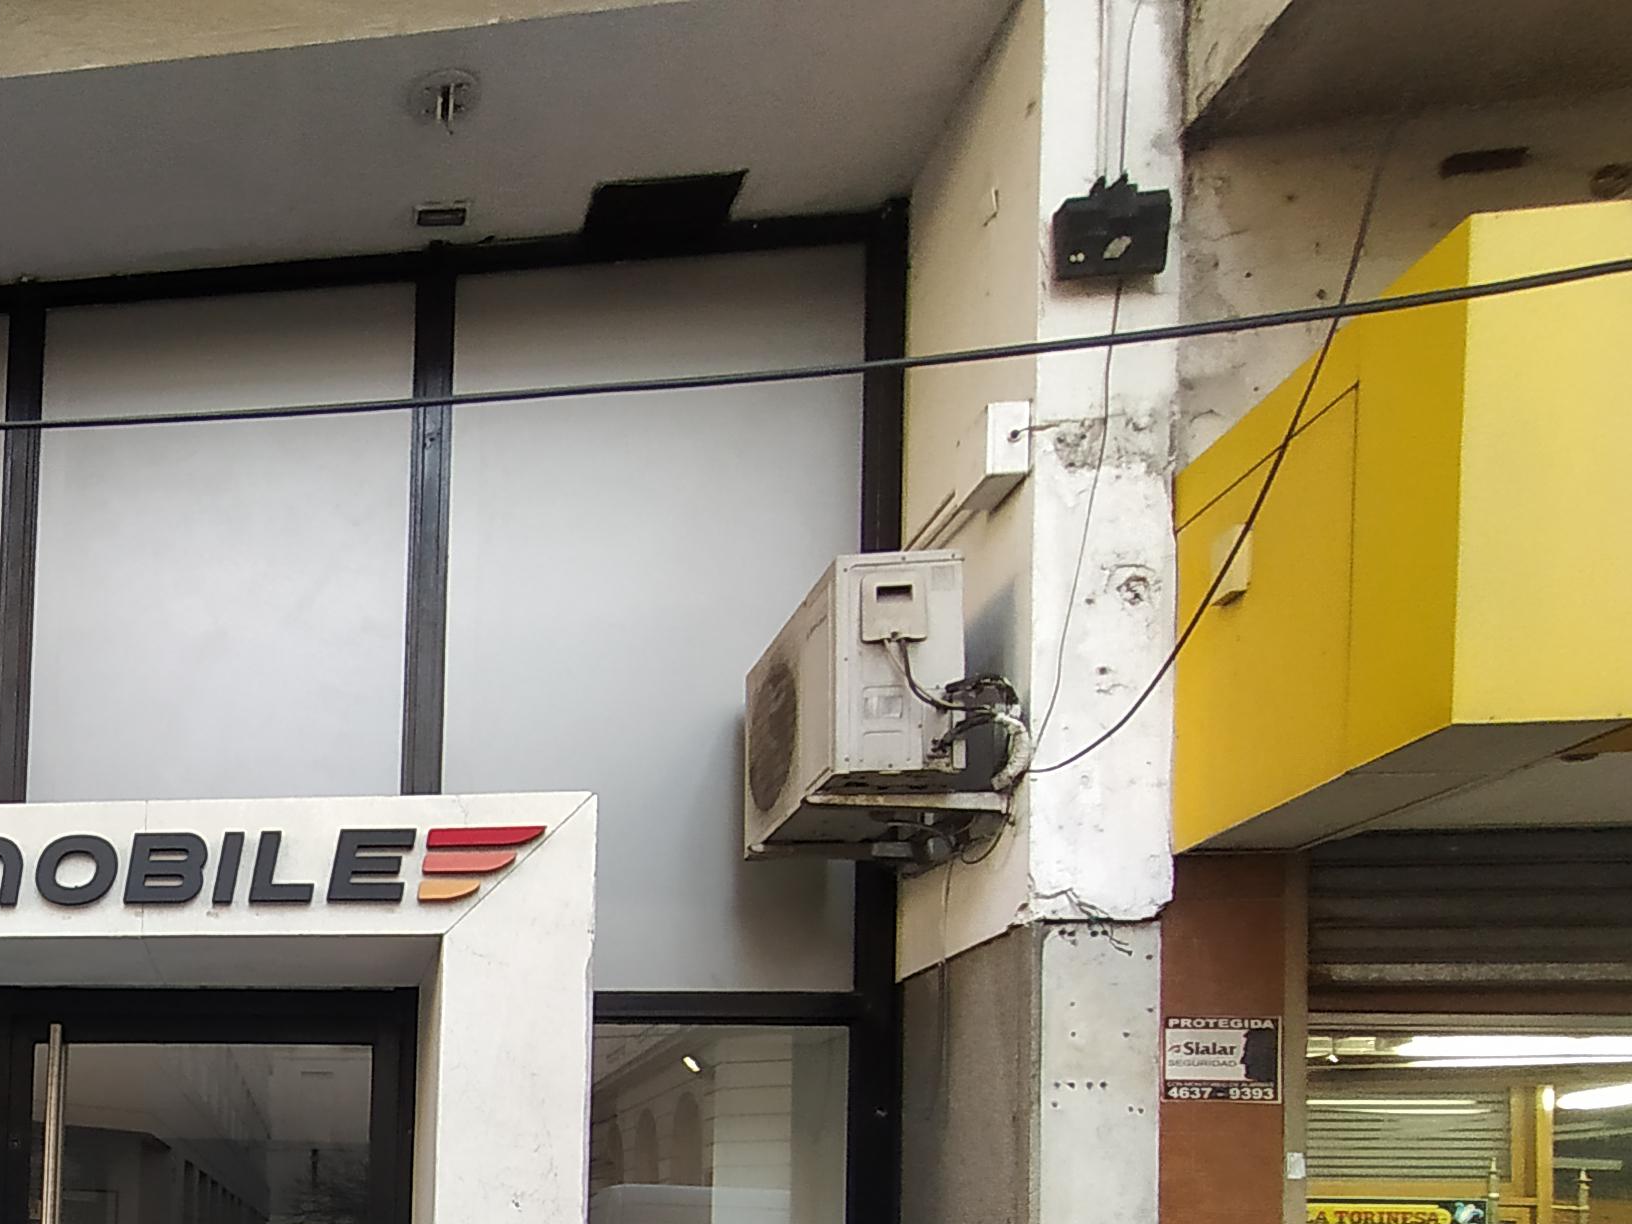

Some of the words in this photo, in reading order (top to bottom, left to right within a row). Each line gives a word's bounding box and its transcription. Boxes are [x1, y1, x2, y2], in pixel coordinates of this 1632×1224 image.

[1168, 1018, 1274, 1029] PROTEGIDA
[1168, 1059, 1238, 1068] SEGURIDAD
[1168, 1087, 1213, 1099] 4637
[1229, 1087, 1275, 1100] 9393
